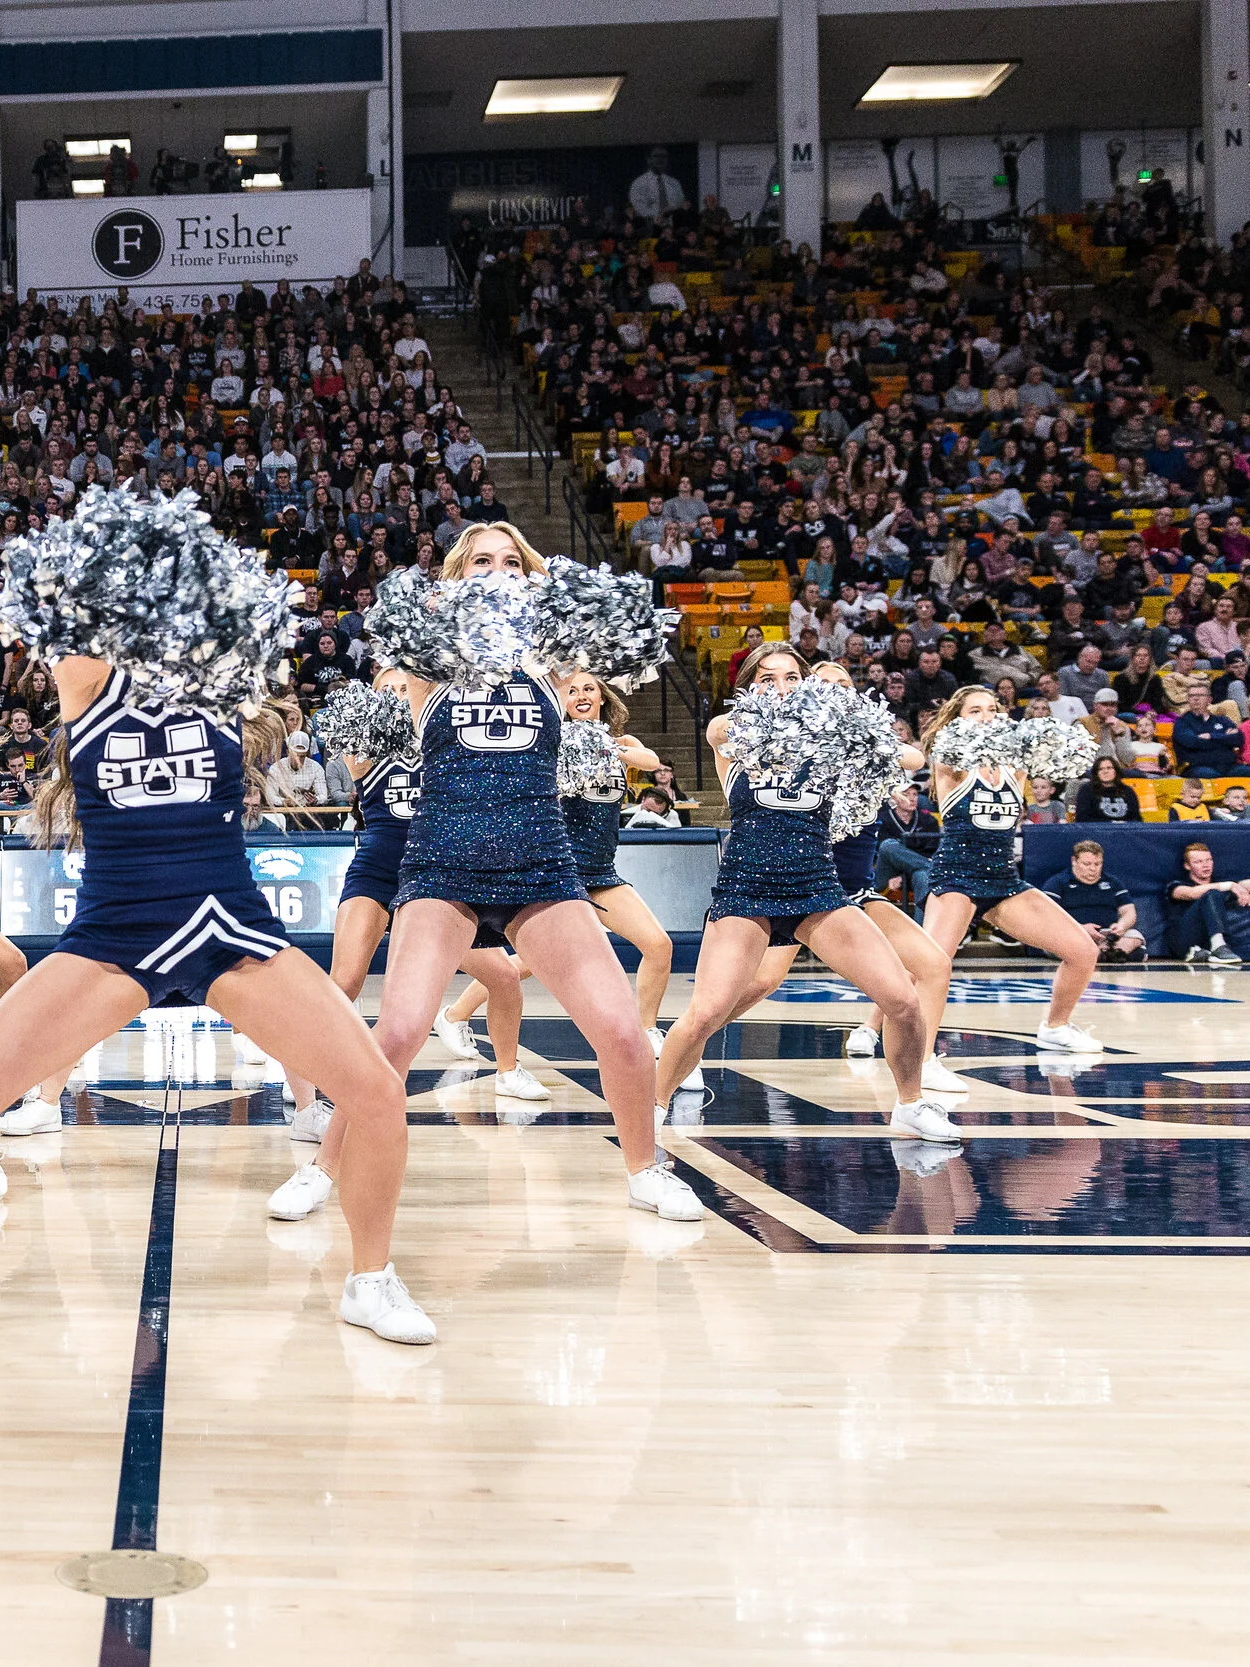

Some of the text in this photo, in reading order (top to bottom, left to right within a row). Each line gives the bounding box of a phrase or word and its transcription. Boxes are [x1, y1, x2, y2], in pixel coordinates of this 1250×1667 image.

[1224, 128, 1243, 147] N
[791, 143, 812, 161] M
[112, 212, 292, 265] F Fisher
[170, 249, 299, 268] Home Furnishings
[451, 704, 544, 729] STATE
[96, 749, 218, 791] STATE
[384, 787, 422, 805] STA
[968, 800, 1019, 816] STATE
[54, 888, 77, 925] 5
